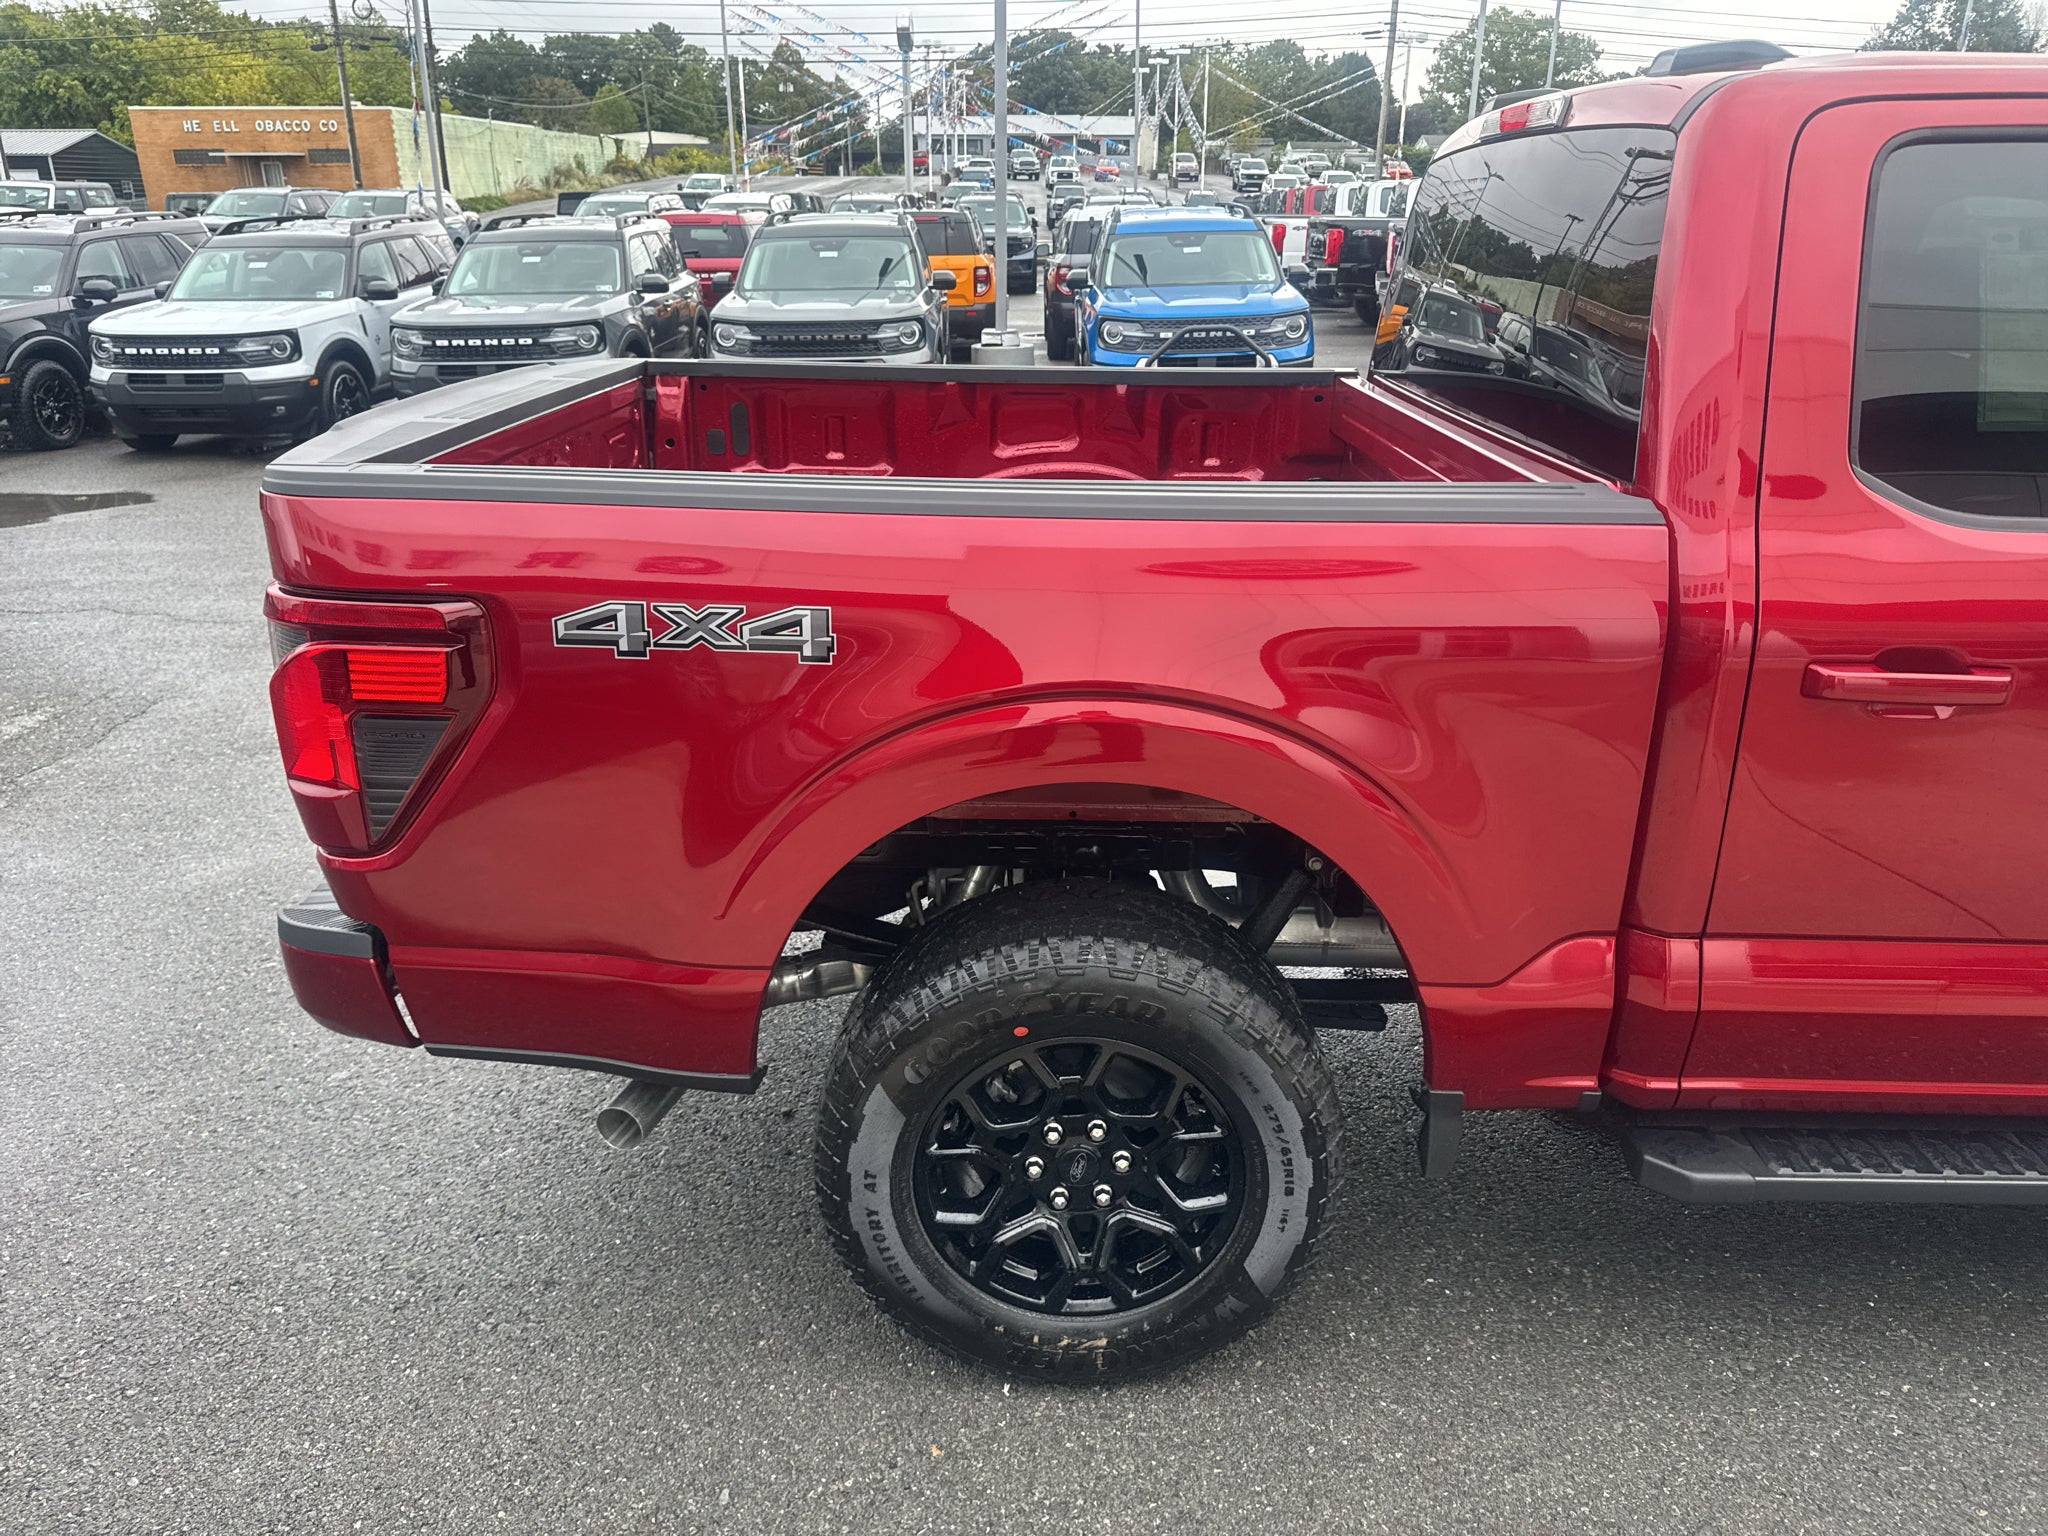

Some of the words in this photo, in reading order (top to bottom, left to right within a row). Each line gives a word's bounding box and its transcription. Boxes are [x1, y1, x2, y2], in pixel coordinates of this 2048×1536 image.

[255, 120, 311, 132] OBACCO
[319, 120, 338, 132] CO
[766, 333, 863, 342] BRONCO
[435, 338, 533, 347] BRONCO
[124, 347, 220, 355] BRONCO
[863, 1169, 878, 1194] AT
